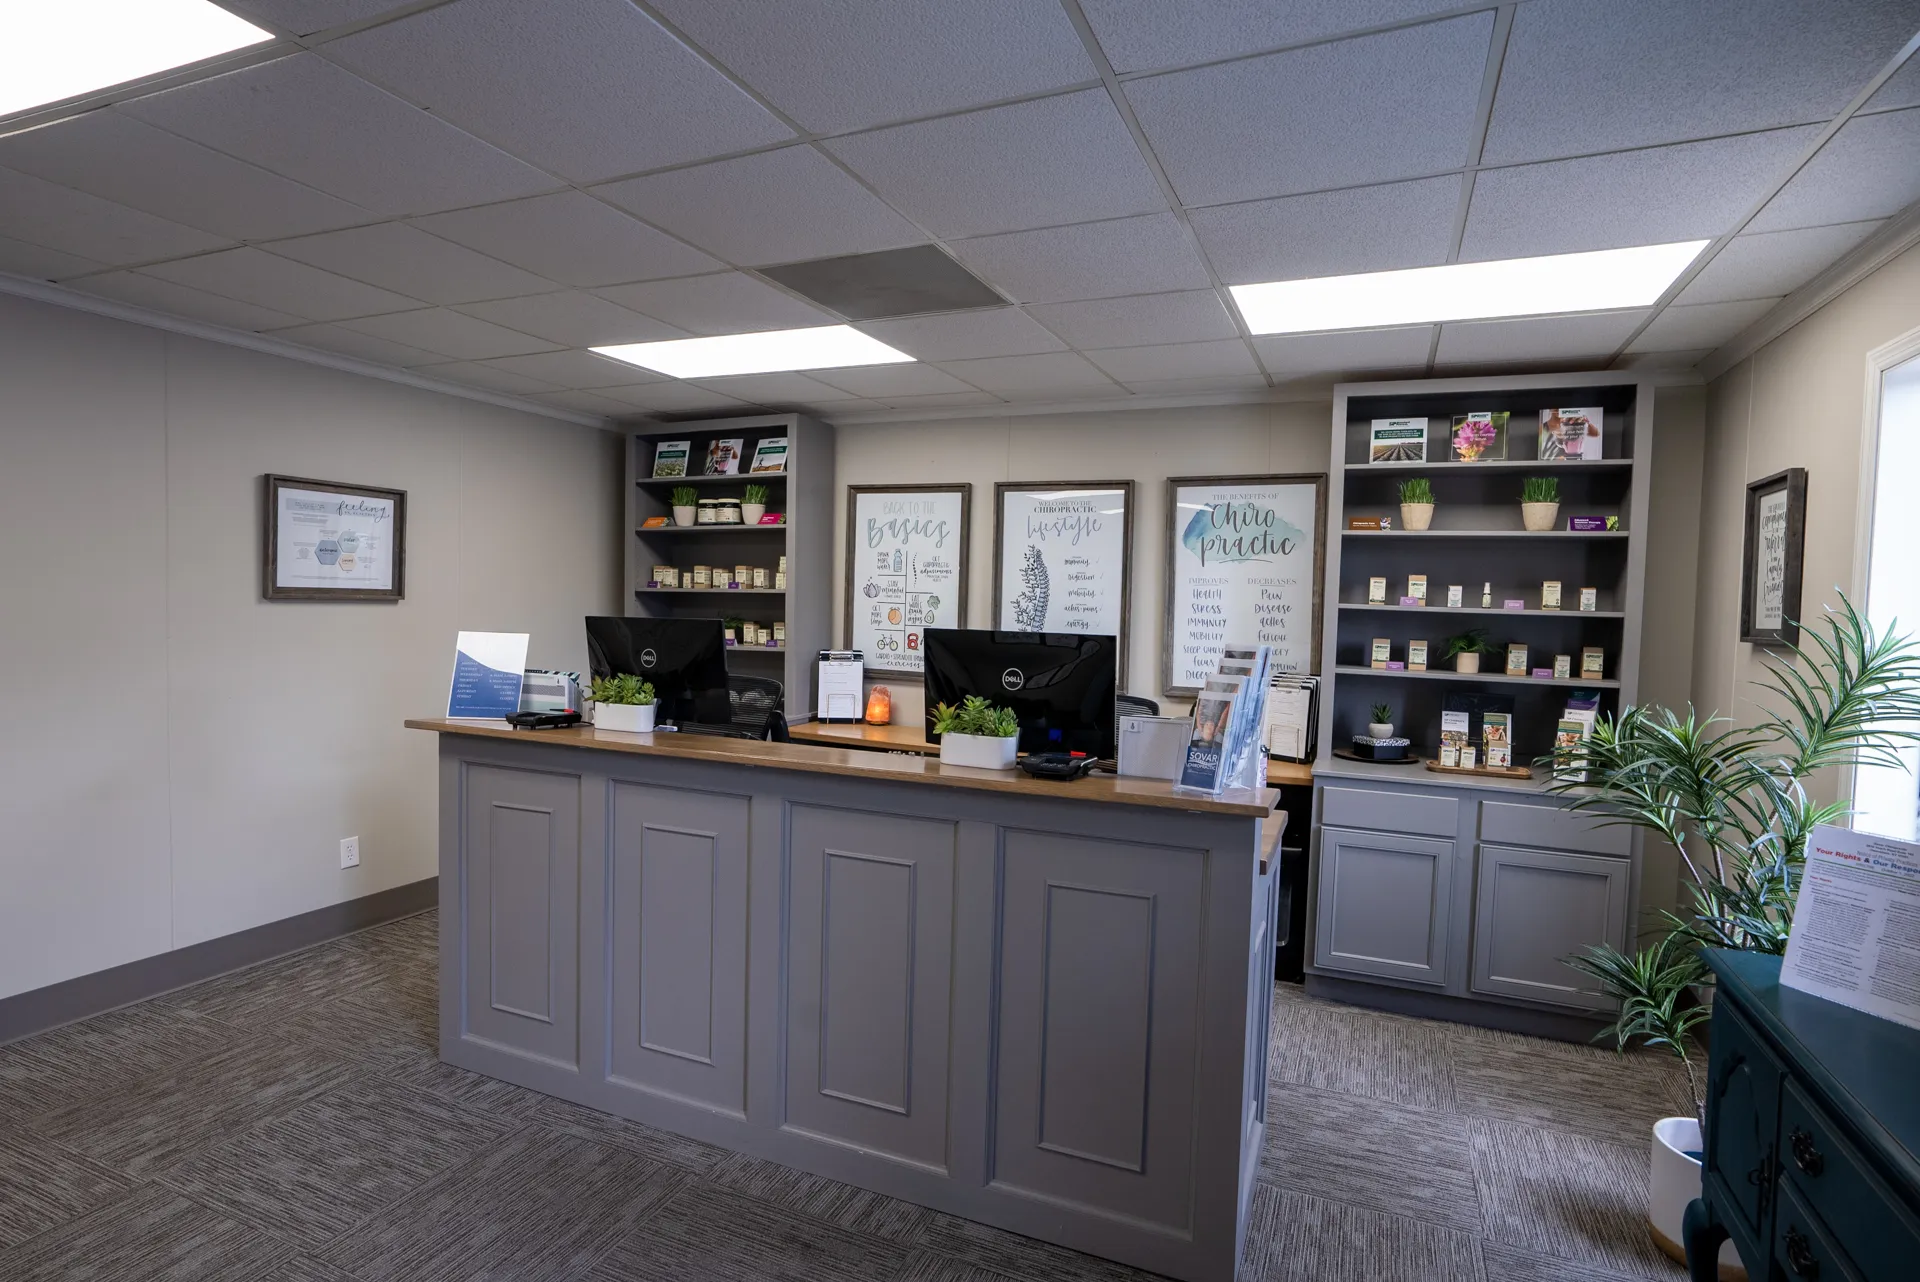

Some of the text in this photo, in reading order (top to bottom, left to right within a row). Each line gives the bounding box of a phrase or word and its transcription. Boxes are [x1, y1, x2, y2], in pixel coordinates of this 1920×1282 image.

[884, 501, 937, 516] BACK TO THE
[1211, 501, 1275, 533] Chiro
[868, 516, 950, 548] Basics
[1201, 530, 1295, 567] practic
[1189, 752, 1217, 762] SOVAR
[1816, 847, 1833, 855] Your
[1835, 851, 1861, 862] Rights
